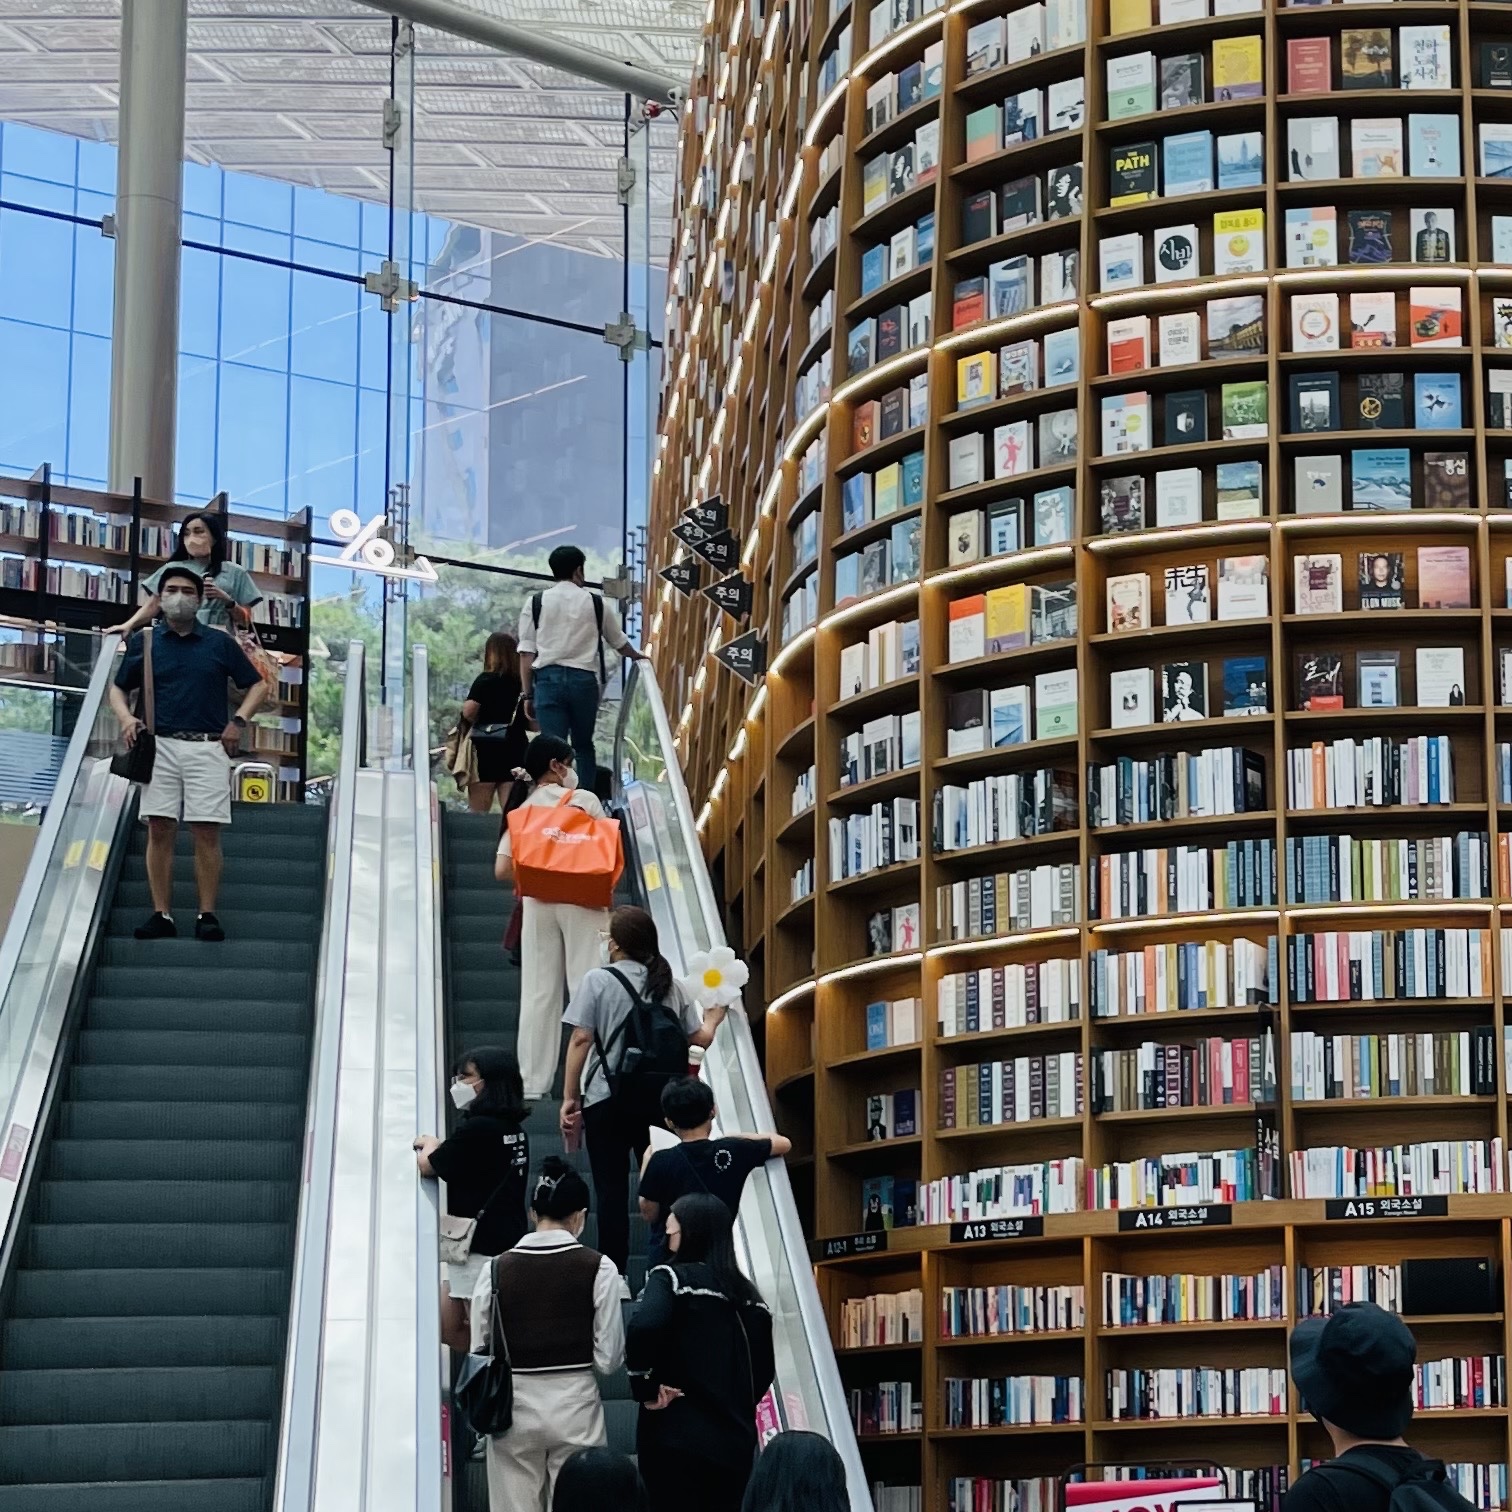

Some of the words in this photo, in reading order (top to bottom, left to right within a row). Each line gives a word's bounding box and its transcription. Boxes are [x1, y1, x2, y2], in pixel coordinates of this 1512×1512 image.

[1115, 154, 1150, 172] PATH
[1160, 239, 1192, 268] 시밤
[695, 508, 717, 521] 주의
[704, 542, 729, 557] 주의
[669, 567, 691, 580] 주의
[715, 586, 741, 602] 주의
[726, 646, 753, 662] 주의
[1264, 1026, 1277, 1085] A
[1344, 1201, 1375, 1217] A15
[1380, 1198, 1423, 1210] 외국소설
[1135, 1212, 1163, 1228] A14
[1167, 1207, 1208, 1220] 외국소설
[963, 1225, 987, 1240] A13
[990, 1219, 1024, 1232] 외국소설
